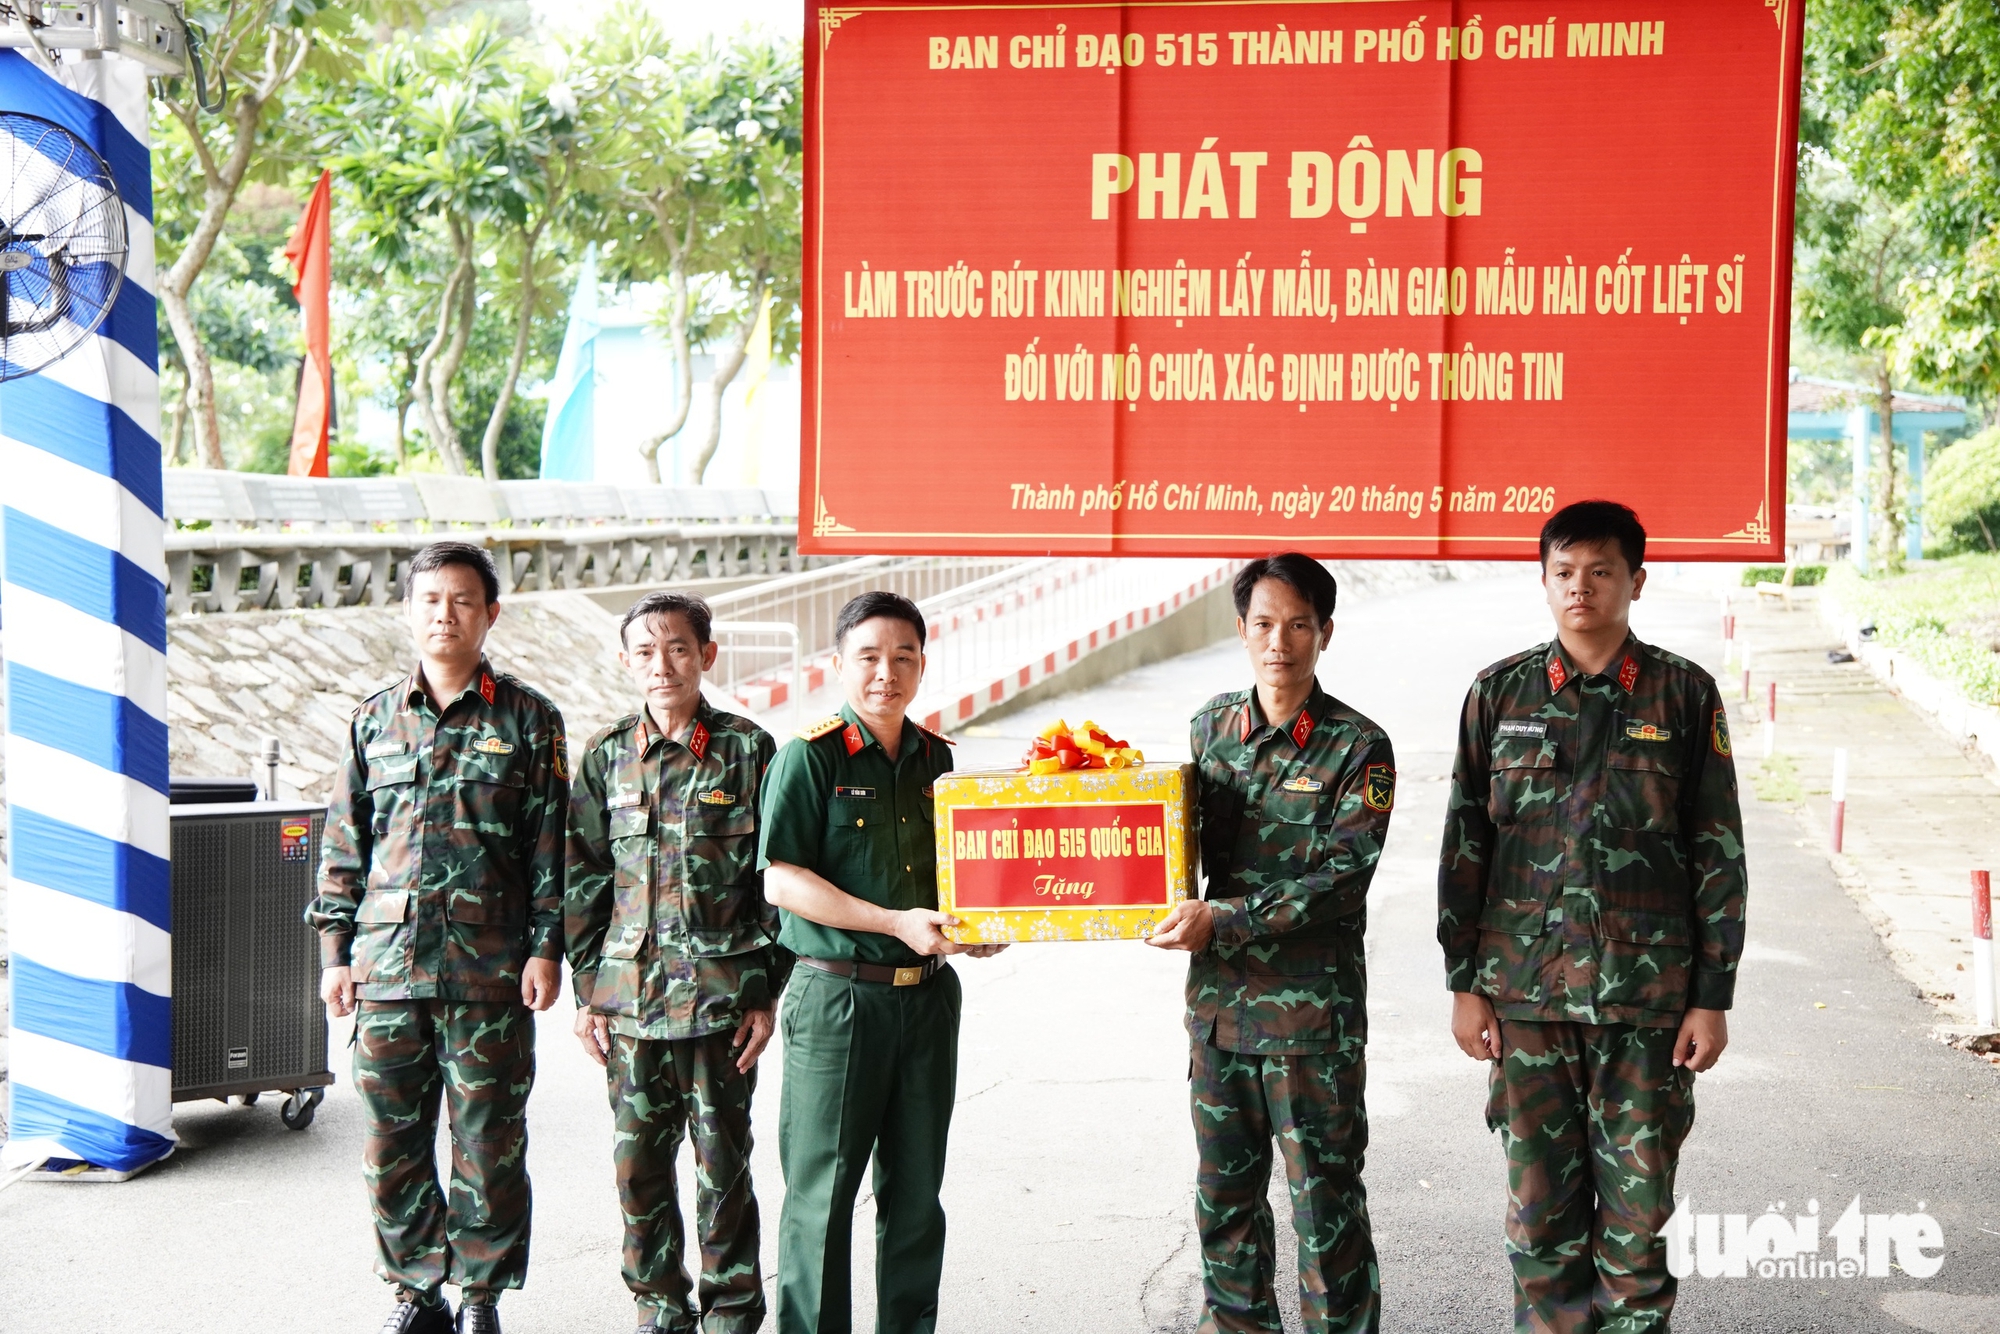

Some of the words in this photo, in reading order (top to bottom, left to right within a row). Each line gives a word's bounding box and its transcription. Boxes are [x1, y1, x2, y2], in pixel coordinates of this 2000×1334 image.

[929, 36, 998, 69] BAN
[1010, 24, 1066, 68] CHỈ
[1076, 33, 1144, 74] ĐẠO
[1156, 33, 1217, 66] 515
[1229, 24, 1342, 65] THÀNH
[1355, 16, 1426, 63] PHỐ
[1436, 15, 1483, 61] HỒ
[1496, 17, 1556, 59] CHÍ
[1567, 21, 1664, 57] MINH
[1091, 137, 1268, 220] PHÁT
[1288, 135, 1482, 234] ĐỘNG
[844, 261, 897, 318] LÀM
[904, 260, 983, 318] TRƯỚC
[991, 260, 1038, 318] RÚT
[1045, 270, 1105, 317] KINH
[1112, 259, 1211, 328] NGHIỆM
[1219, 252, 1265, 316] LẤY
[1272, 250, 1337, 323] MẪU,
[1346, 258, 1399, 316] BÀN
[1407, 267, 1467, 316] GIAO
[1475, 247, 1534, 315] MẪU
[1543, 255, 1586, 314] HÀI
[1595, 248, 1646, 314] CỐT
[1653, 254, 1708, 324] LIỆT
[1716, 254, 1745, 313] SĨ
[1004, 336, 1047, 401] ĐỐI
[1054, 343, 1094, 401] VỚI
[1101, 343, 1141, 411] MỘ
[1149, 348, 1216, 401] CHƯA
[1223, 343, 1274, 402] XÁC
[1281, 354, 1343, 412] ĐỊNH
[1351, 348, 1420, 412] ĐƯỢC
[1428, 342, 1513, 401] THÔNG
[1521, 353, 1563, 400] TIN
[1010, 483, 1075, 510] Thành
[1080, 480, 1127, 517] phố
[1127, 480, 1159, 511] Hồ
[1163, 483, 1203, 511] Chí
[1205, 484, 1263, 516] Minh,
[1270, 484, 1324, 519] ngày
[1329, 485, 1356, 512] 20
[1361, 484, 1425, 519] tháng
[1430, 486, 1443, 512] 5
[1449, 485, 1496, 512] năm
[1502, 486, 1555, 513] 2026
[1515, 725, 1527, 733] DUY
[955, 830, 987, 860] BAN
[991, 818, 1018, 859] CHỈ
[1024, 828, 1054, 867] ĐẠO
[1059, 828, 1085, 858] 515
[1090, 815, 1132, 861] QUỐC
[1136, 826, 1164, 857] GIA
[1033, 874, 1096, 901] Tặng
